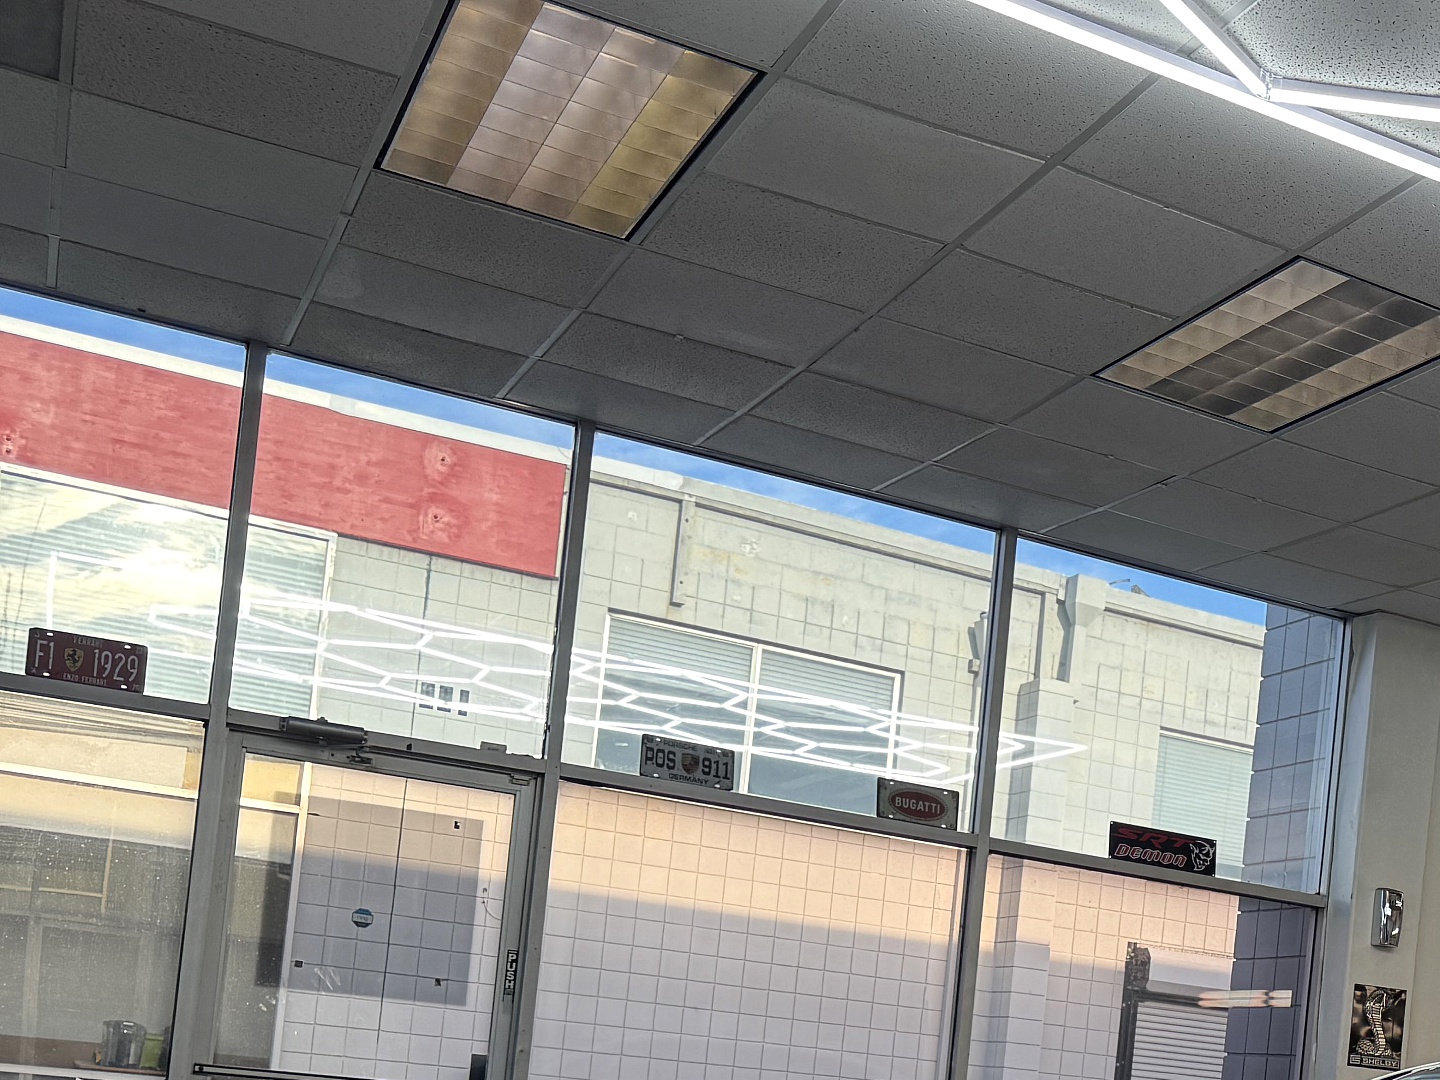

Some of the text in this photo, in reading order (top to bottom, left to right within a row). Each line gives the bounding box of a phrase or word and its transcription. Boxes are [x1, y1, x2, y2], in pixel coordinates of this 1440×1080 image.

[35, 640, 139, 681] F1 1929
[669, 773, 709, 785] GERMANY
[702, 757, 731, 780] 911
[895, 796, 940, 814] BUGATTI
[1113, 827, 1196, 848] SRT
[505, 953, 516, 989] PUSH
